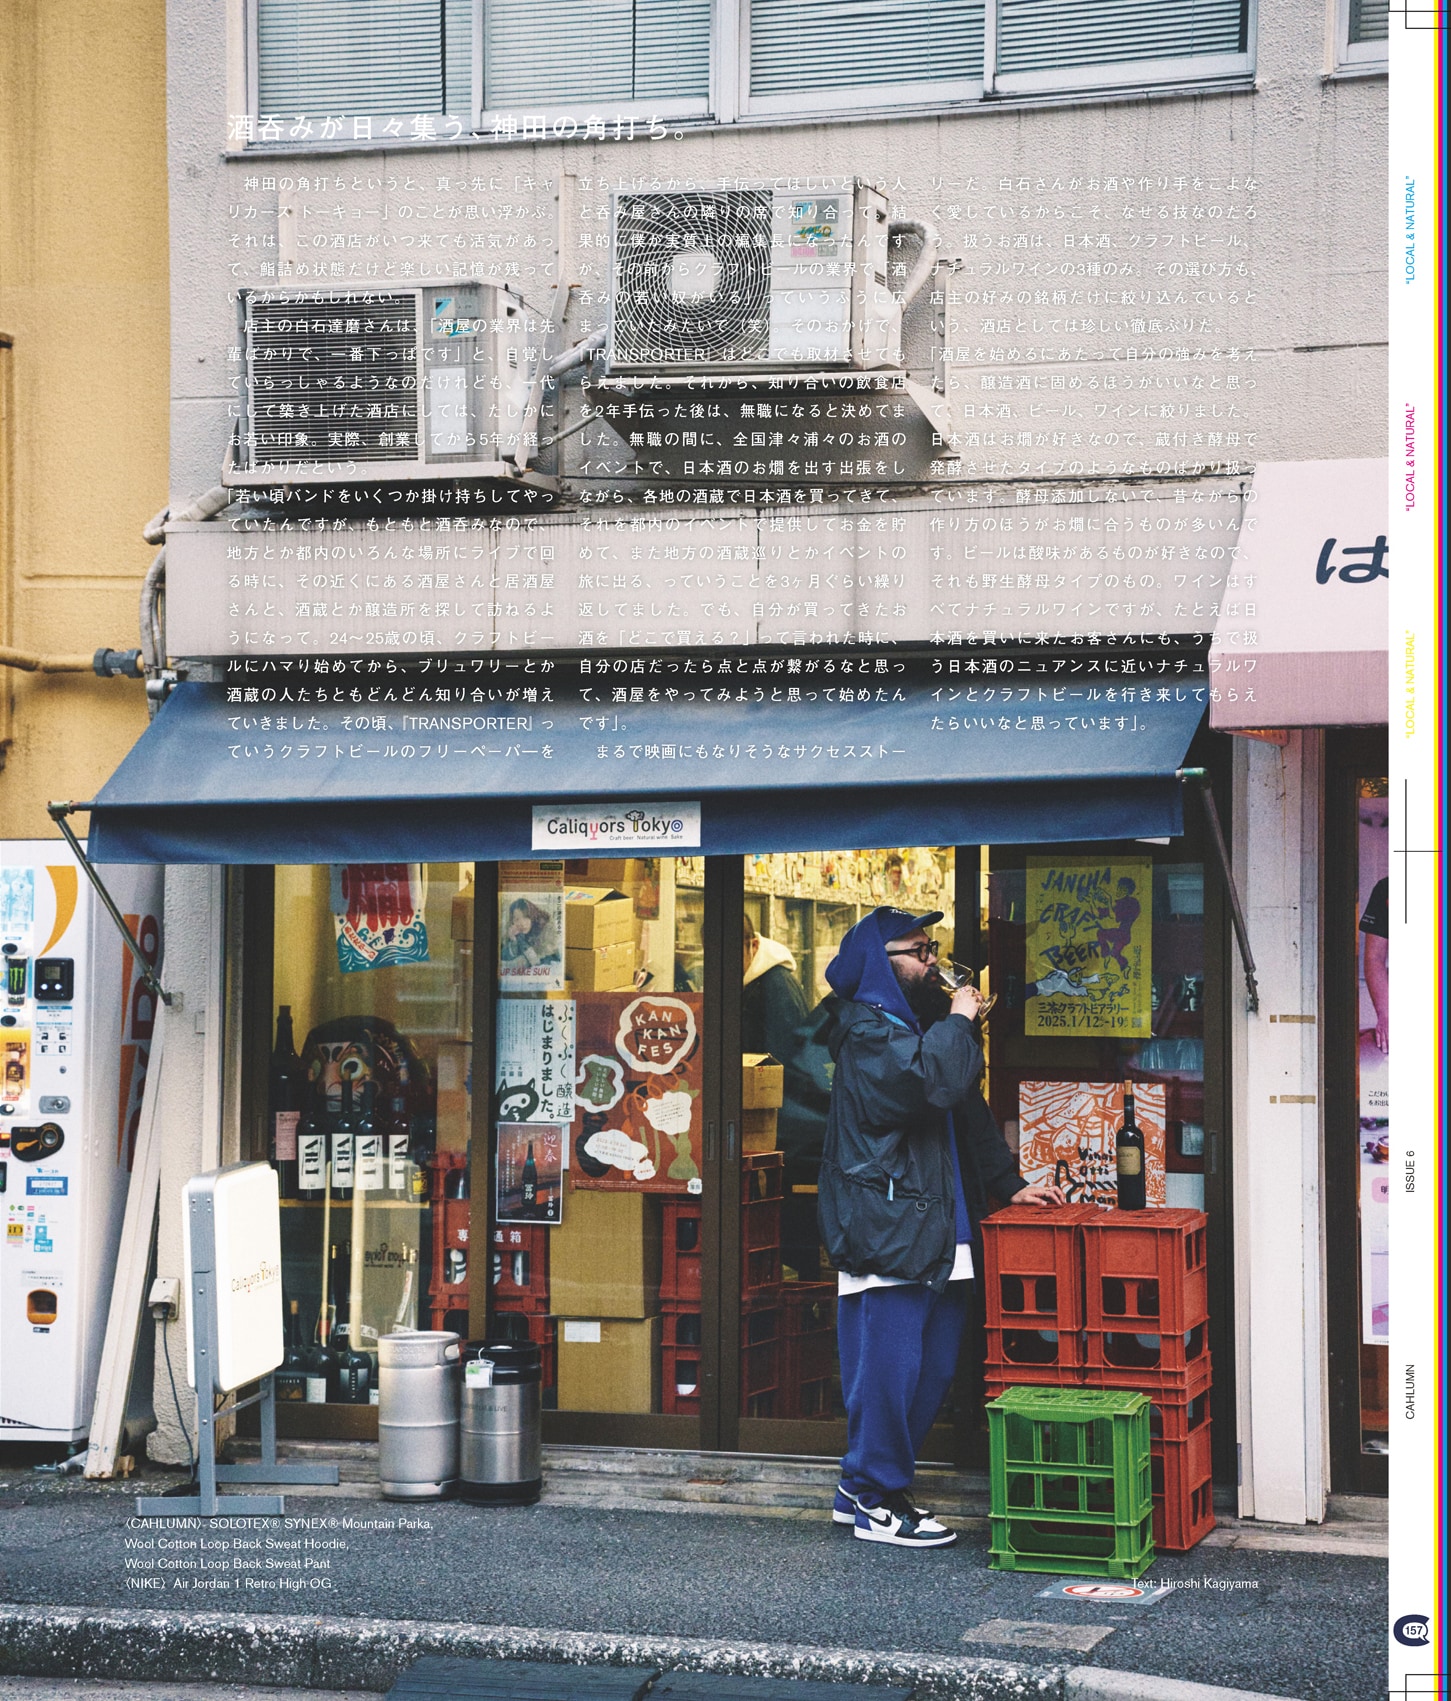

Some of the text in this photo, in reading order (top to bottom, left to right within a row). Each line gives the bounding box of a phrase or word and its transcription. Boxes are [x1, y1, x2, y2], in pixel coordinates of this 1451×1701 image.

[547, 818, 625, 840] Caliquors
[635, 1011, 672, 1027] KAN
[643, 1025, 682, 1040] KAN
[637, 1042, 673, 1057] FES
[540, 1004, 554, 1119] はじまりました。
